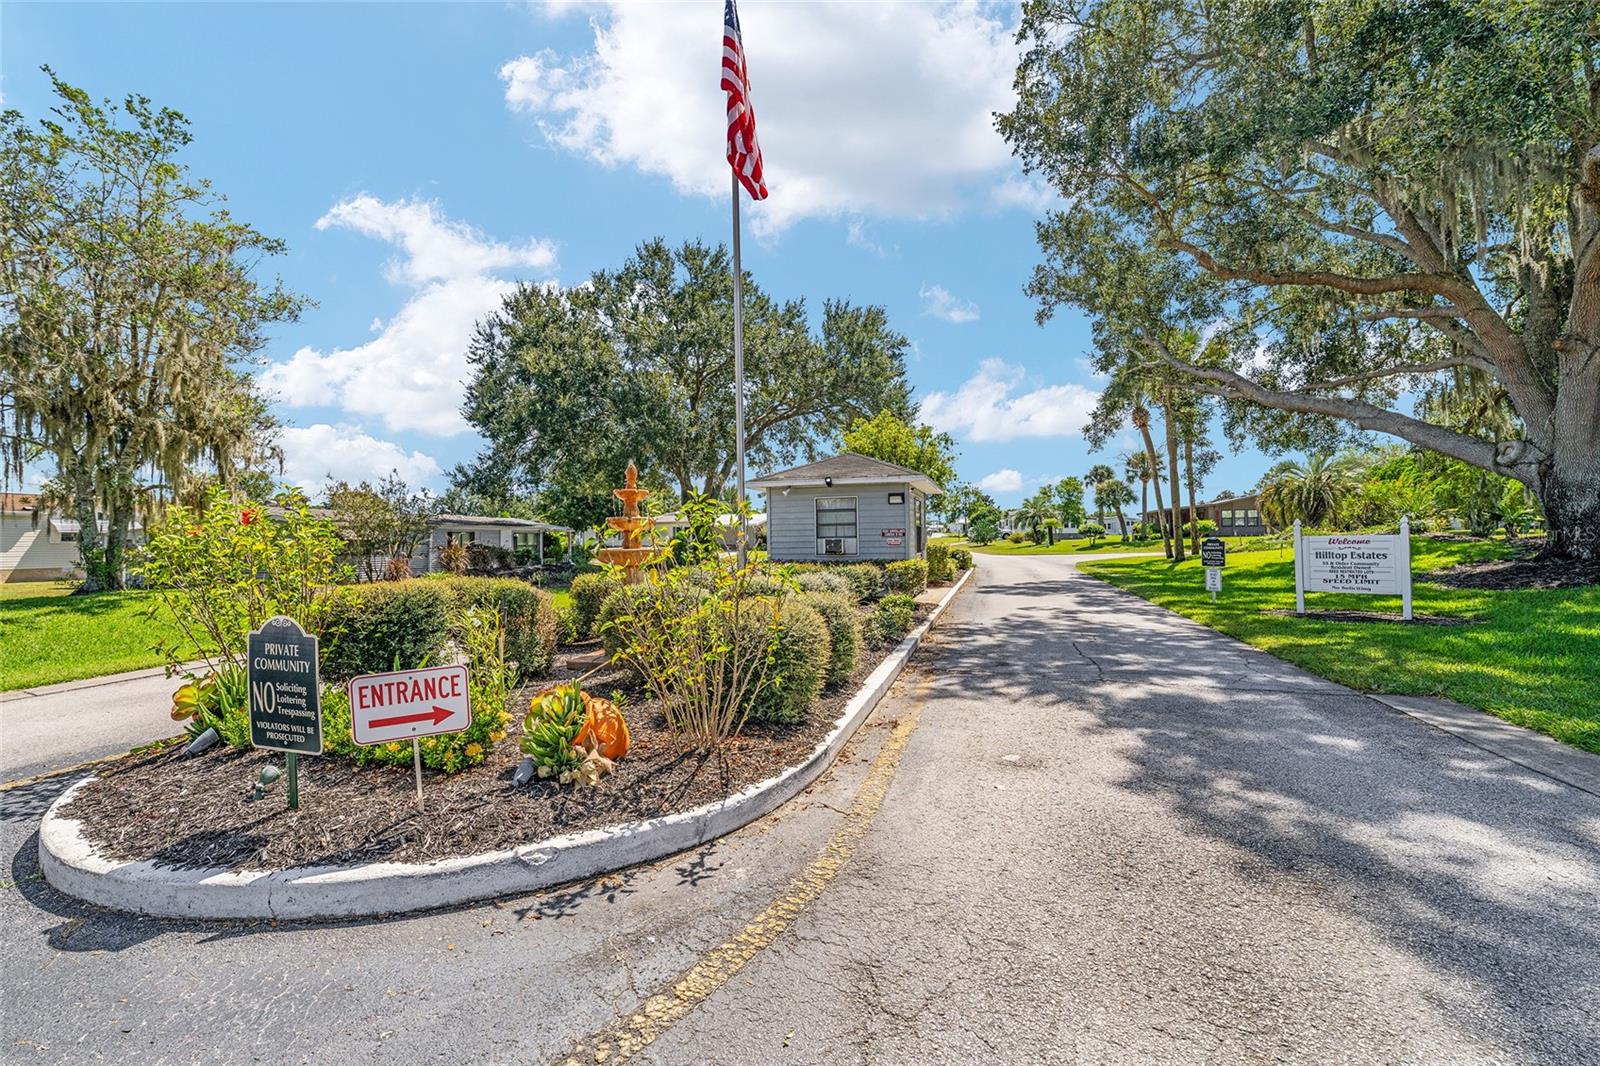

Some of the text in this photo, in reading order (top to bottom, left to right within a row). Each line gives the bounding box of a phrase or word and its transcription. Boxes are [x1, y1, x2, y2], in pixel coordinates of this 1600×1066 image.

[1315, 551, 1388, 560] Hilltop Estates
[264, 643, 300, 656] PRIVATE
[254, 658, 310, 673] COMMUNITY
[276, 682, 307, 696] Soliciting
[358, 674, 461, 709] ENTRANCE
[252, 680, 275, 714] NO
[276, 694, 306, 708] Loitering
[277, 706, 316, 720] Trespassing
[256, 721, 315, 734] VIOLATORS WILL BE
[266, 732, 305, 743] PROSECUTED
